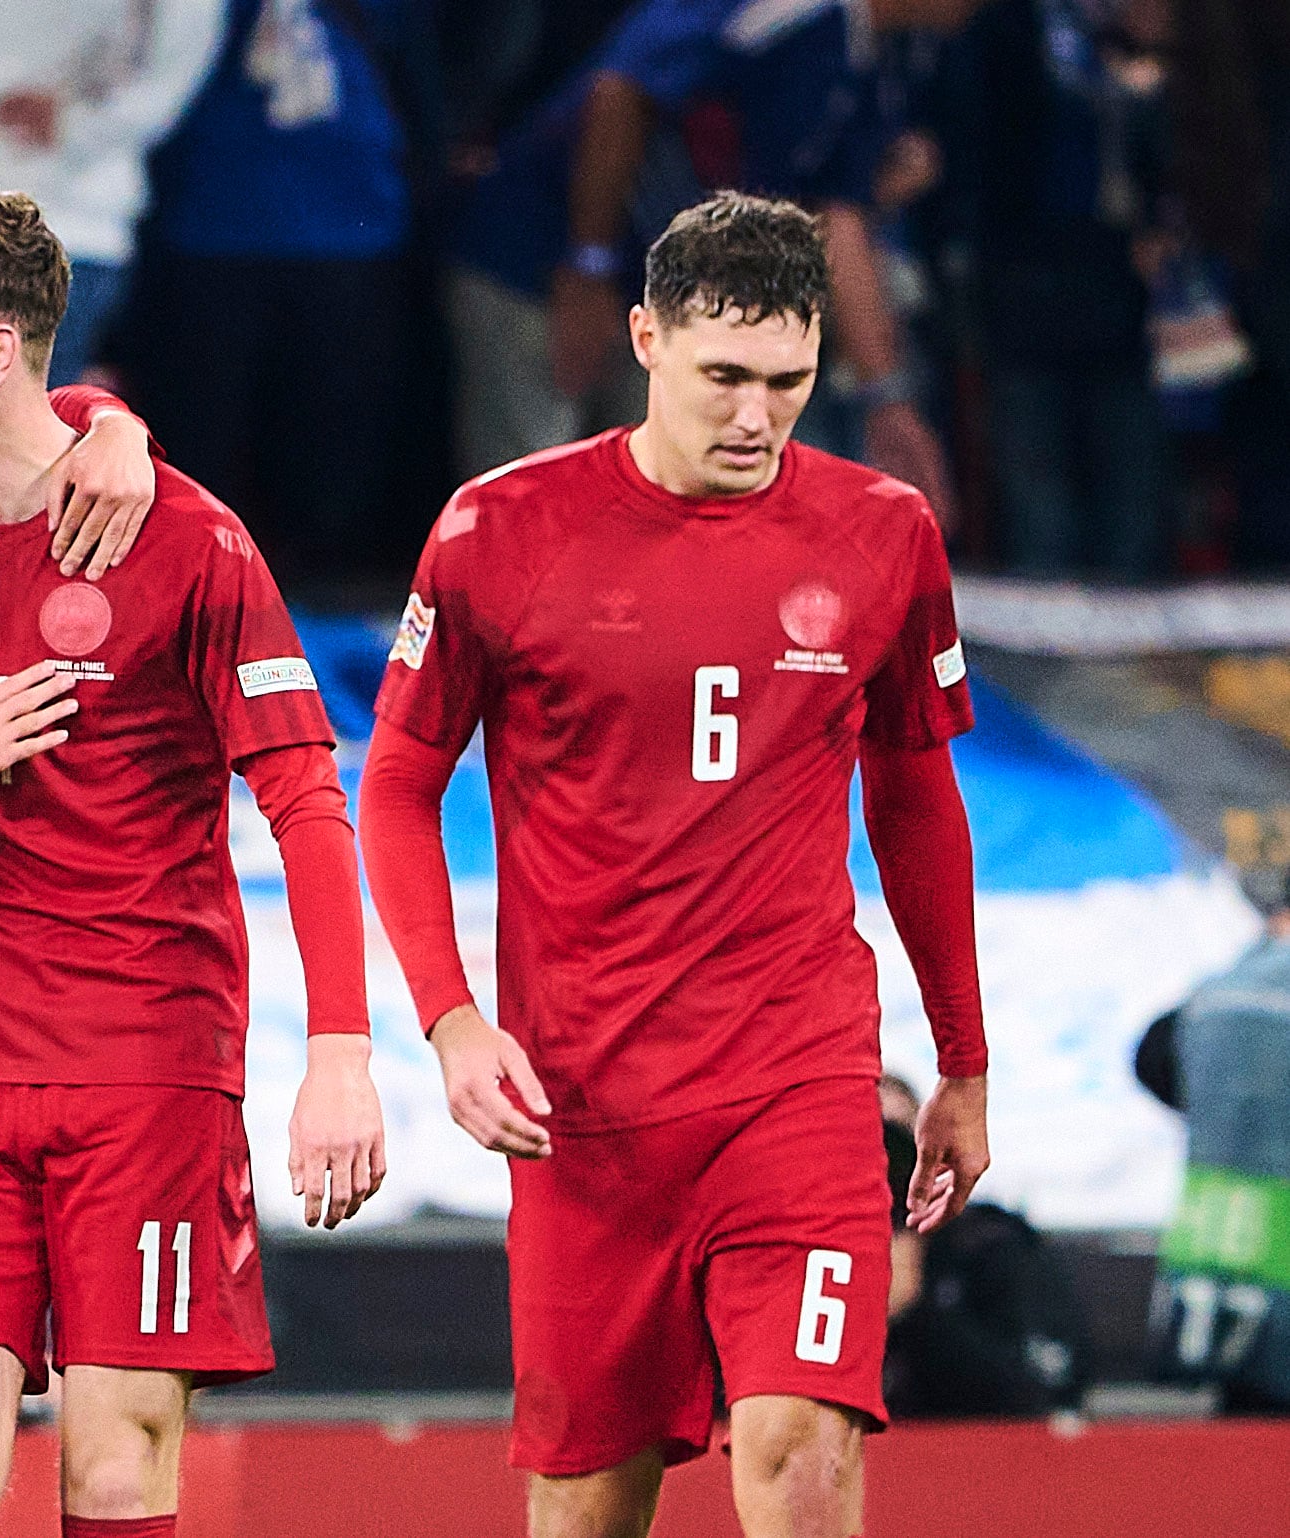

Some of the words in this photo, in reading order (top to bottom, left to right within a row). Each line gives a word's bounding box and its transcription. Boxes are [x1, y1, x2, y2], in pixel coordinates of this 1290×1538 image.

[692, 665, 739, 781] 6
[137, 1221, 191, 1333] 11
[795, 1249, 852, 1365] 6
